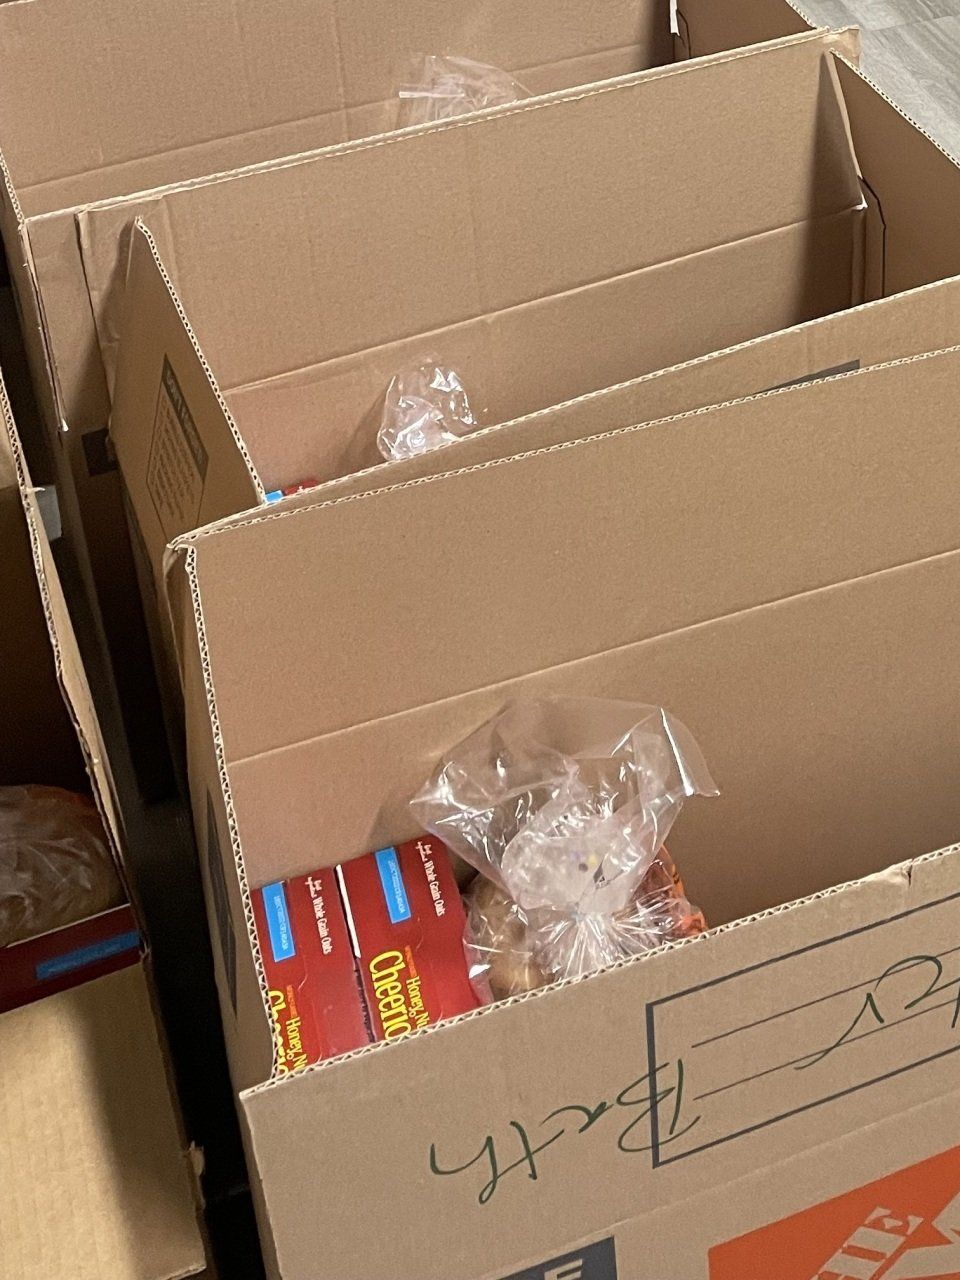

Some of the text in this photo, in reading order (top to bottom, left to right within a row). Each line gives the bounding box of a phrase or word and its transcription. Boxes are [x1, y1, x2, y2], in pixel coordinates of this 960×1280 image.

[423, 860, 437, 887] Whole
[369, 950, 412, 1040] Cheerio
[405, 976, 425, 1017] Honey
[285, 1016, 304, 1061] Honey
